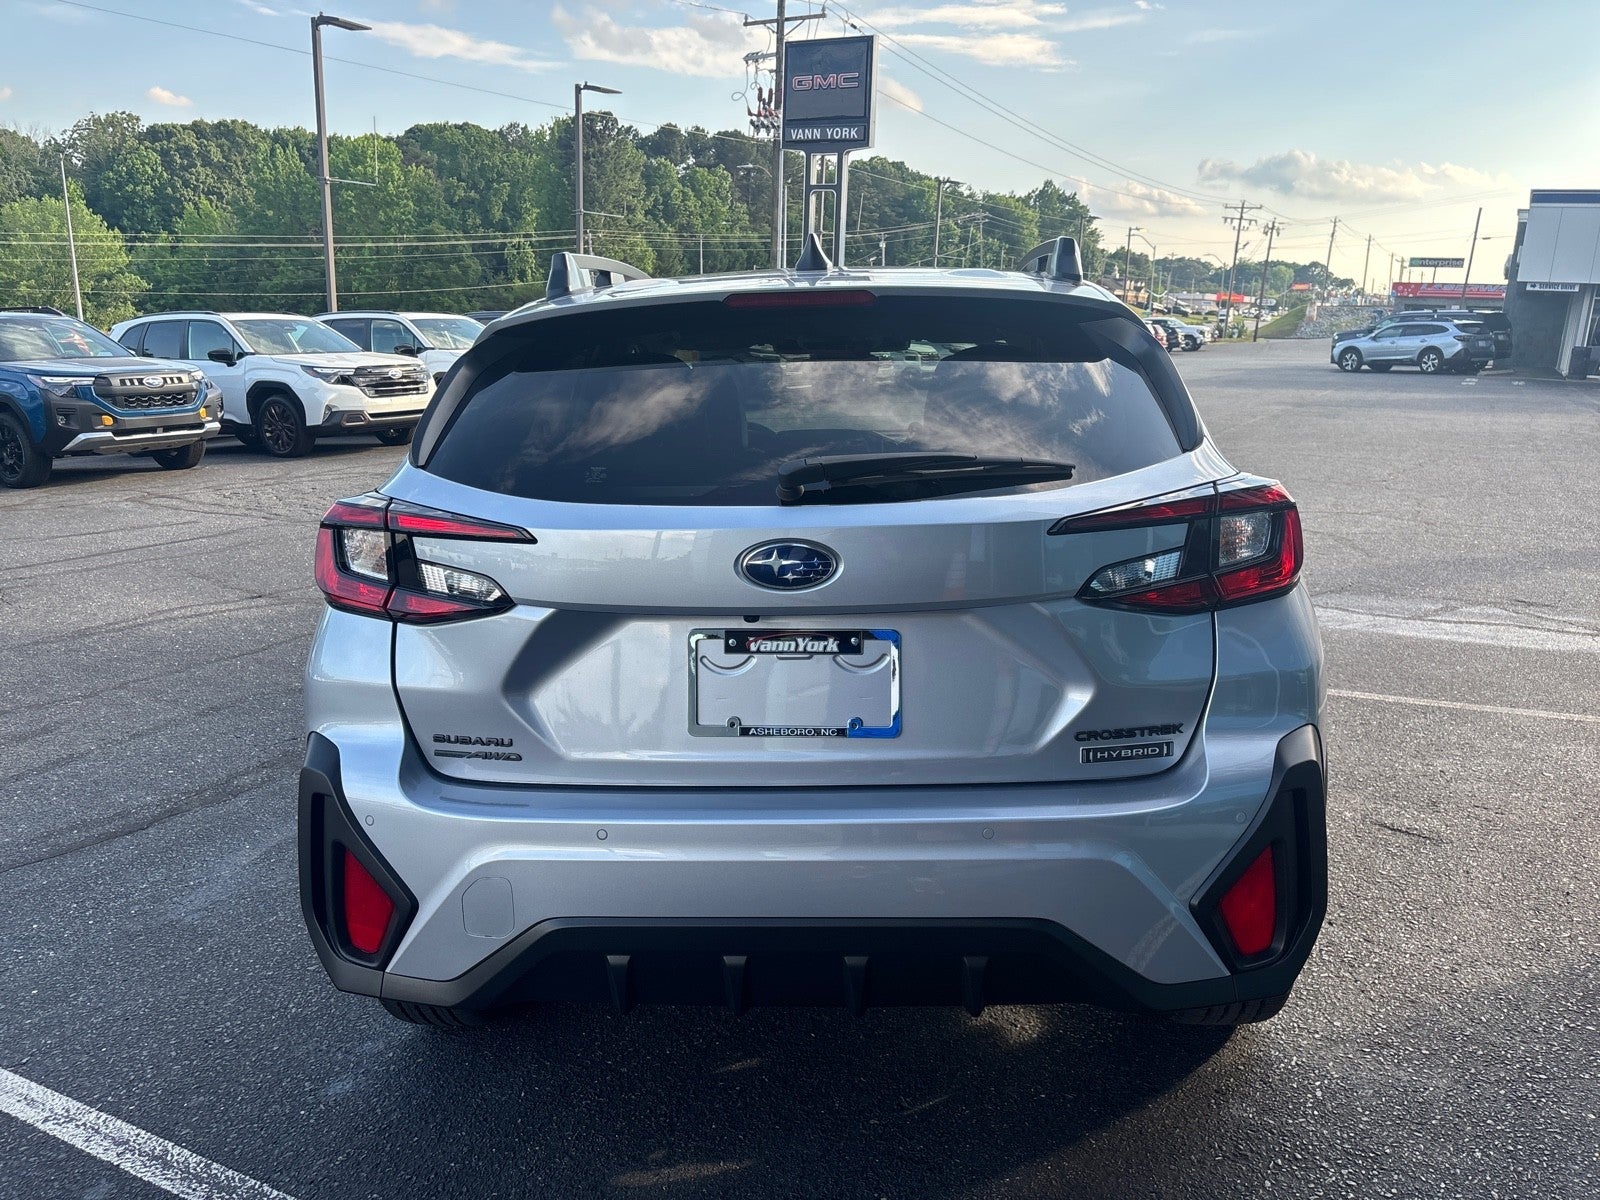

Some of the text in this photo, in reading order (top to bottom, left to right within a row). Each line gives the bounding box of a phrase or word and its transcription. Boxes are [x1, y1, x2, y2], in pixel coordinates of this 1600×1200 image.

[792, 72, 859, 91] GMC
[791, 127, 858, 139] VANN YORK
[1411, 258, 1464, 267] enterprise
[749, 727, 837, 737] ASHEBORO, NC
[1074, 722, 1184, 742] CROSSTREK
[432, 733, 513, 747] SUBARU
[466, 750, 522, 761] AWD
[1097, 747, 1160, 759] HYBRID
